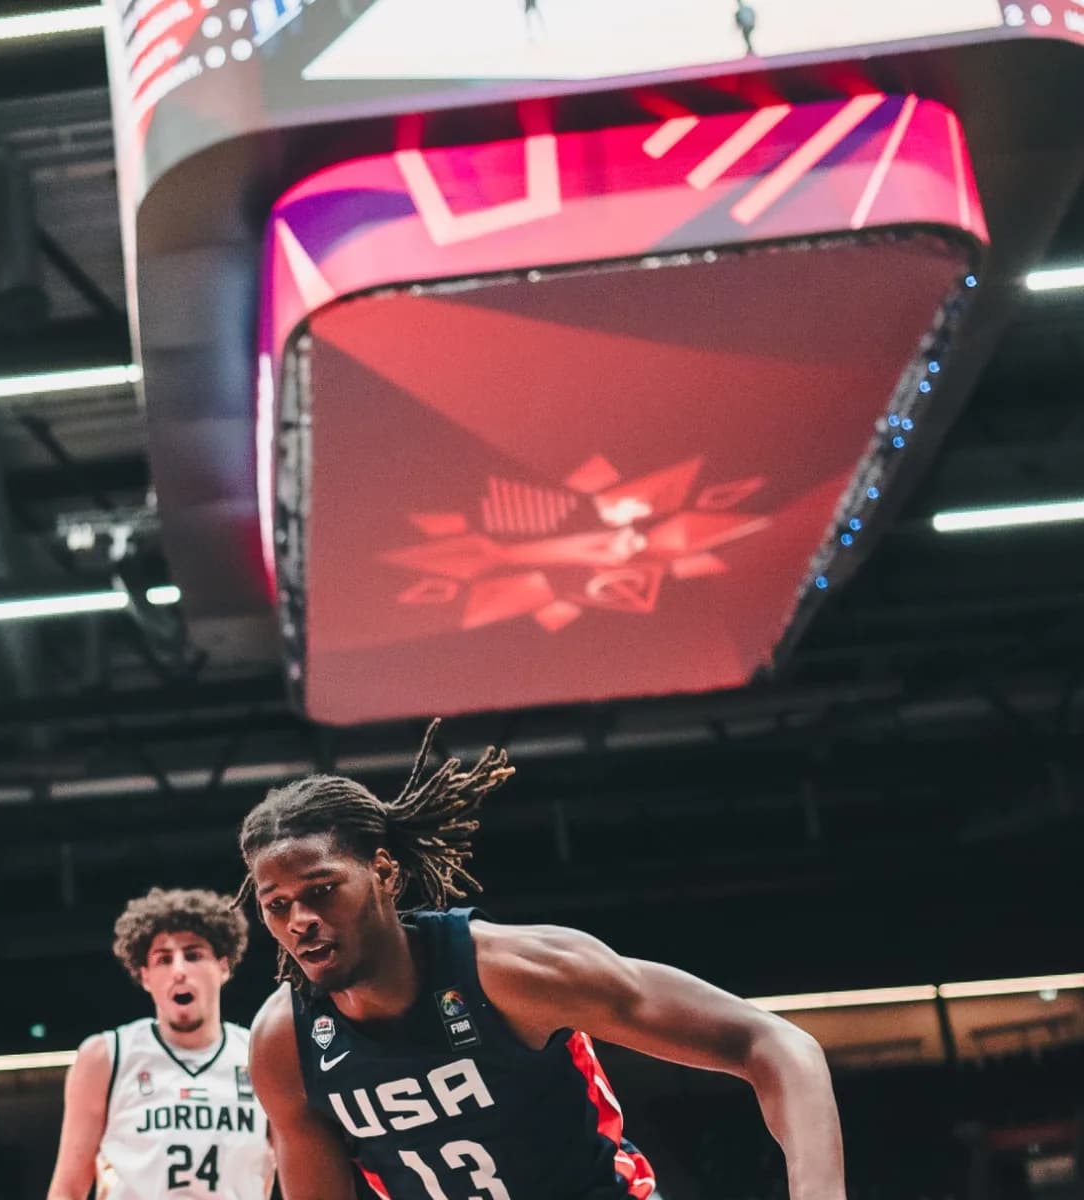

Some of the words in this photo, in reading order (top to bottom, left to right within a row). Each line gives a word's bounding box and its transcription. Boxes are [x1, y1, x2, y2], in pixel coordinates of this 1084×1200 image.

[136, 1104, 255, 1133] JORDAN
[328, 1058, 495, 1138] USA
[166, 1144, 220, 1193] 24
